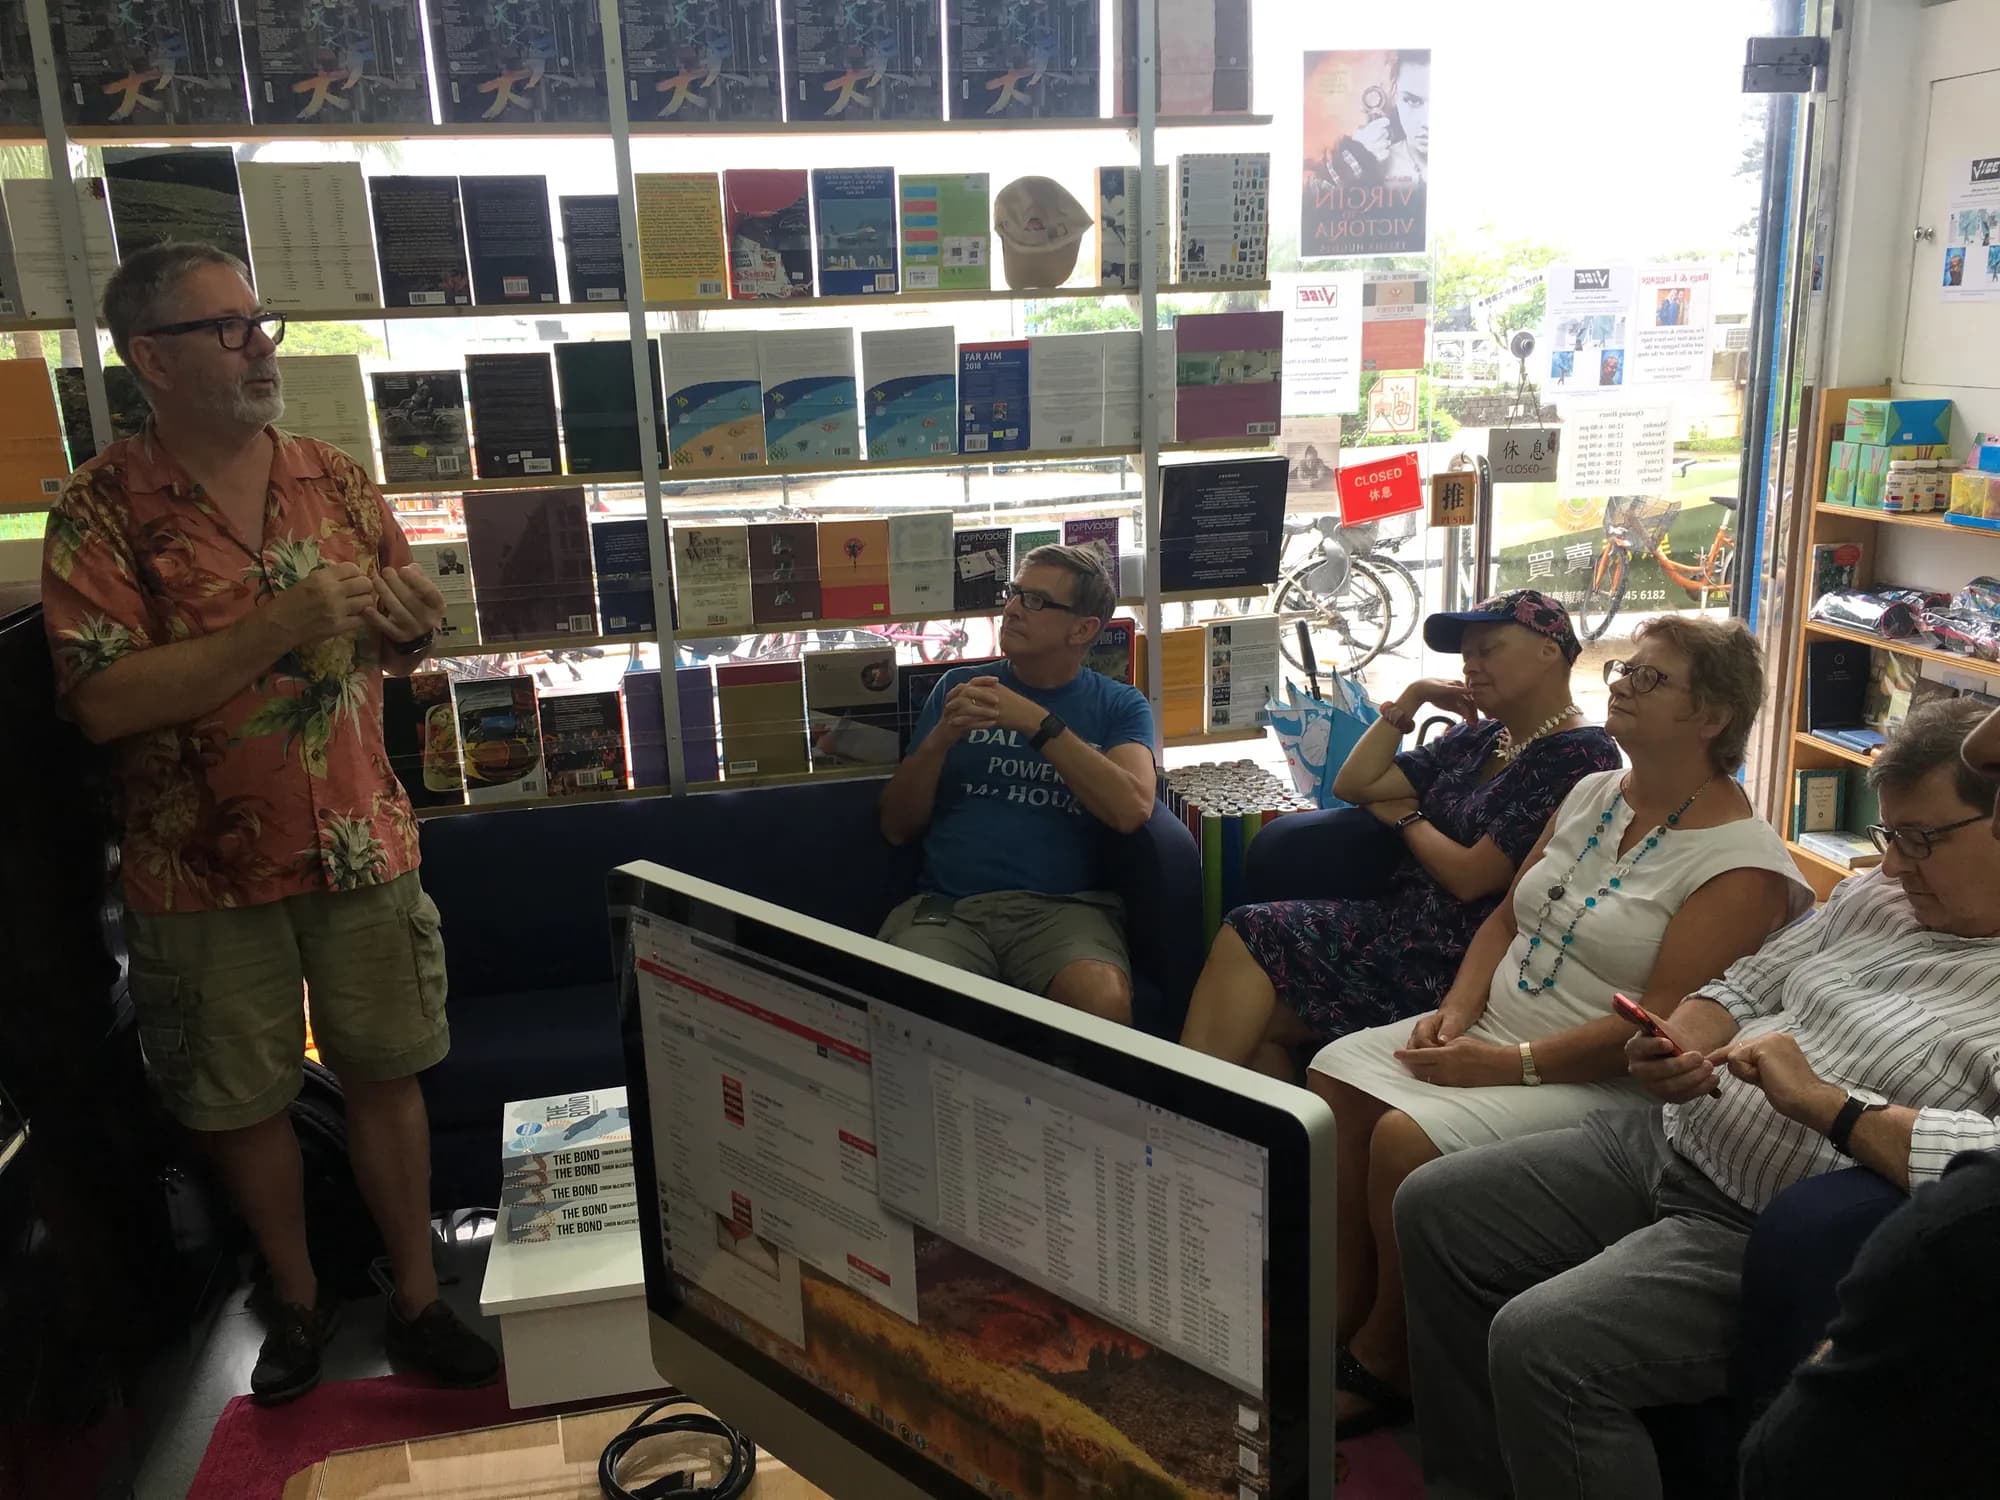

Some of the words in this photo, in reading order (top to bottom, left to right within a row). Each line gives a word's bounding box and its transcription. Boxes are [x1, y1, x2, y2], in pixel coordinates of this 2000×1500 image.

[965, 353, 982, 361] FAR
[983, 352, 1002, 361] AIM
[966, 362, 982, 370] 2018
[1503, 440, 1545, 461] 休息
[1505, 464, 1540, 474] CLOSED
[1354, 468, 1403, 488] CLOSED
[1369, 486, 1393, 502] 休息
[1442, 482, 1465, 511] 推
[1440, 515, 1466, 524] PUSH
[1527, 542, 1593, 583] 買賣
[1640, 590, 1666, 600] 6182
[546, 1104, 568, 1122] THE
[569, 1095, 590, 1118] BOND
[553, 1153, 572, 1166] THE
[574, 1149, 600, 1163] BOND
[554, 1168, 572, 1179] THE
[575, 1163, 601, 1177] BOND
[552, 1187, 571, 1199] THE
[572, 1184, 598, 1198] BOND
[561, 1208, 581, 1219] THE
[583, 1203, 608, 1217] BOND
[556, 1223, 576, 1235] THE
[577, 1220, 603, 1233] BOND
